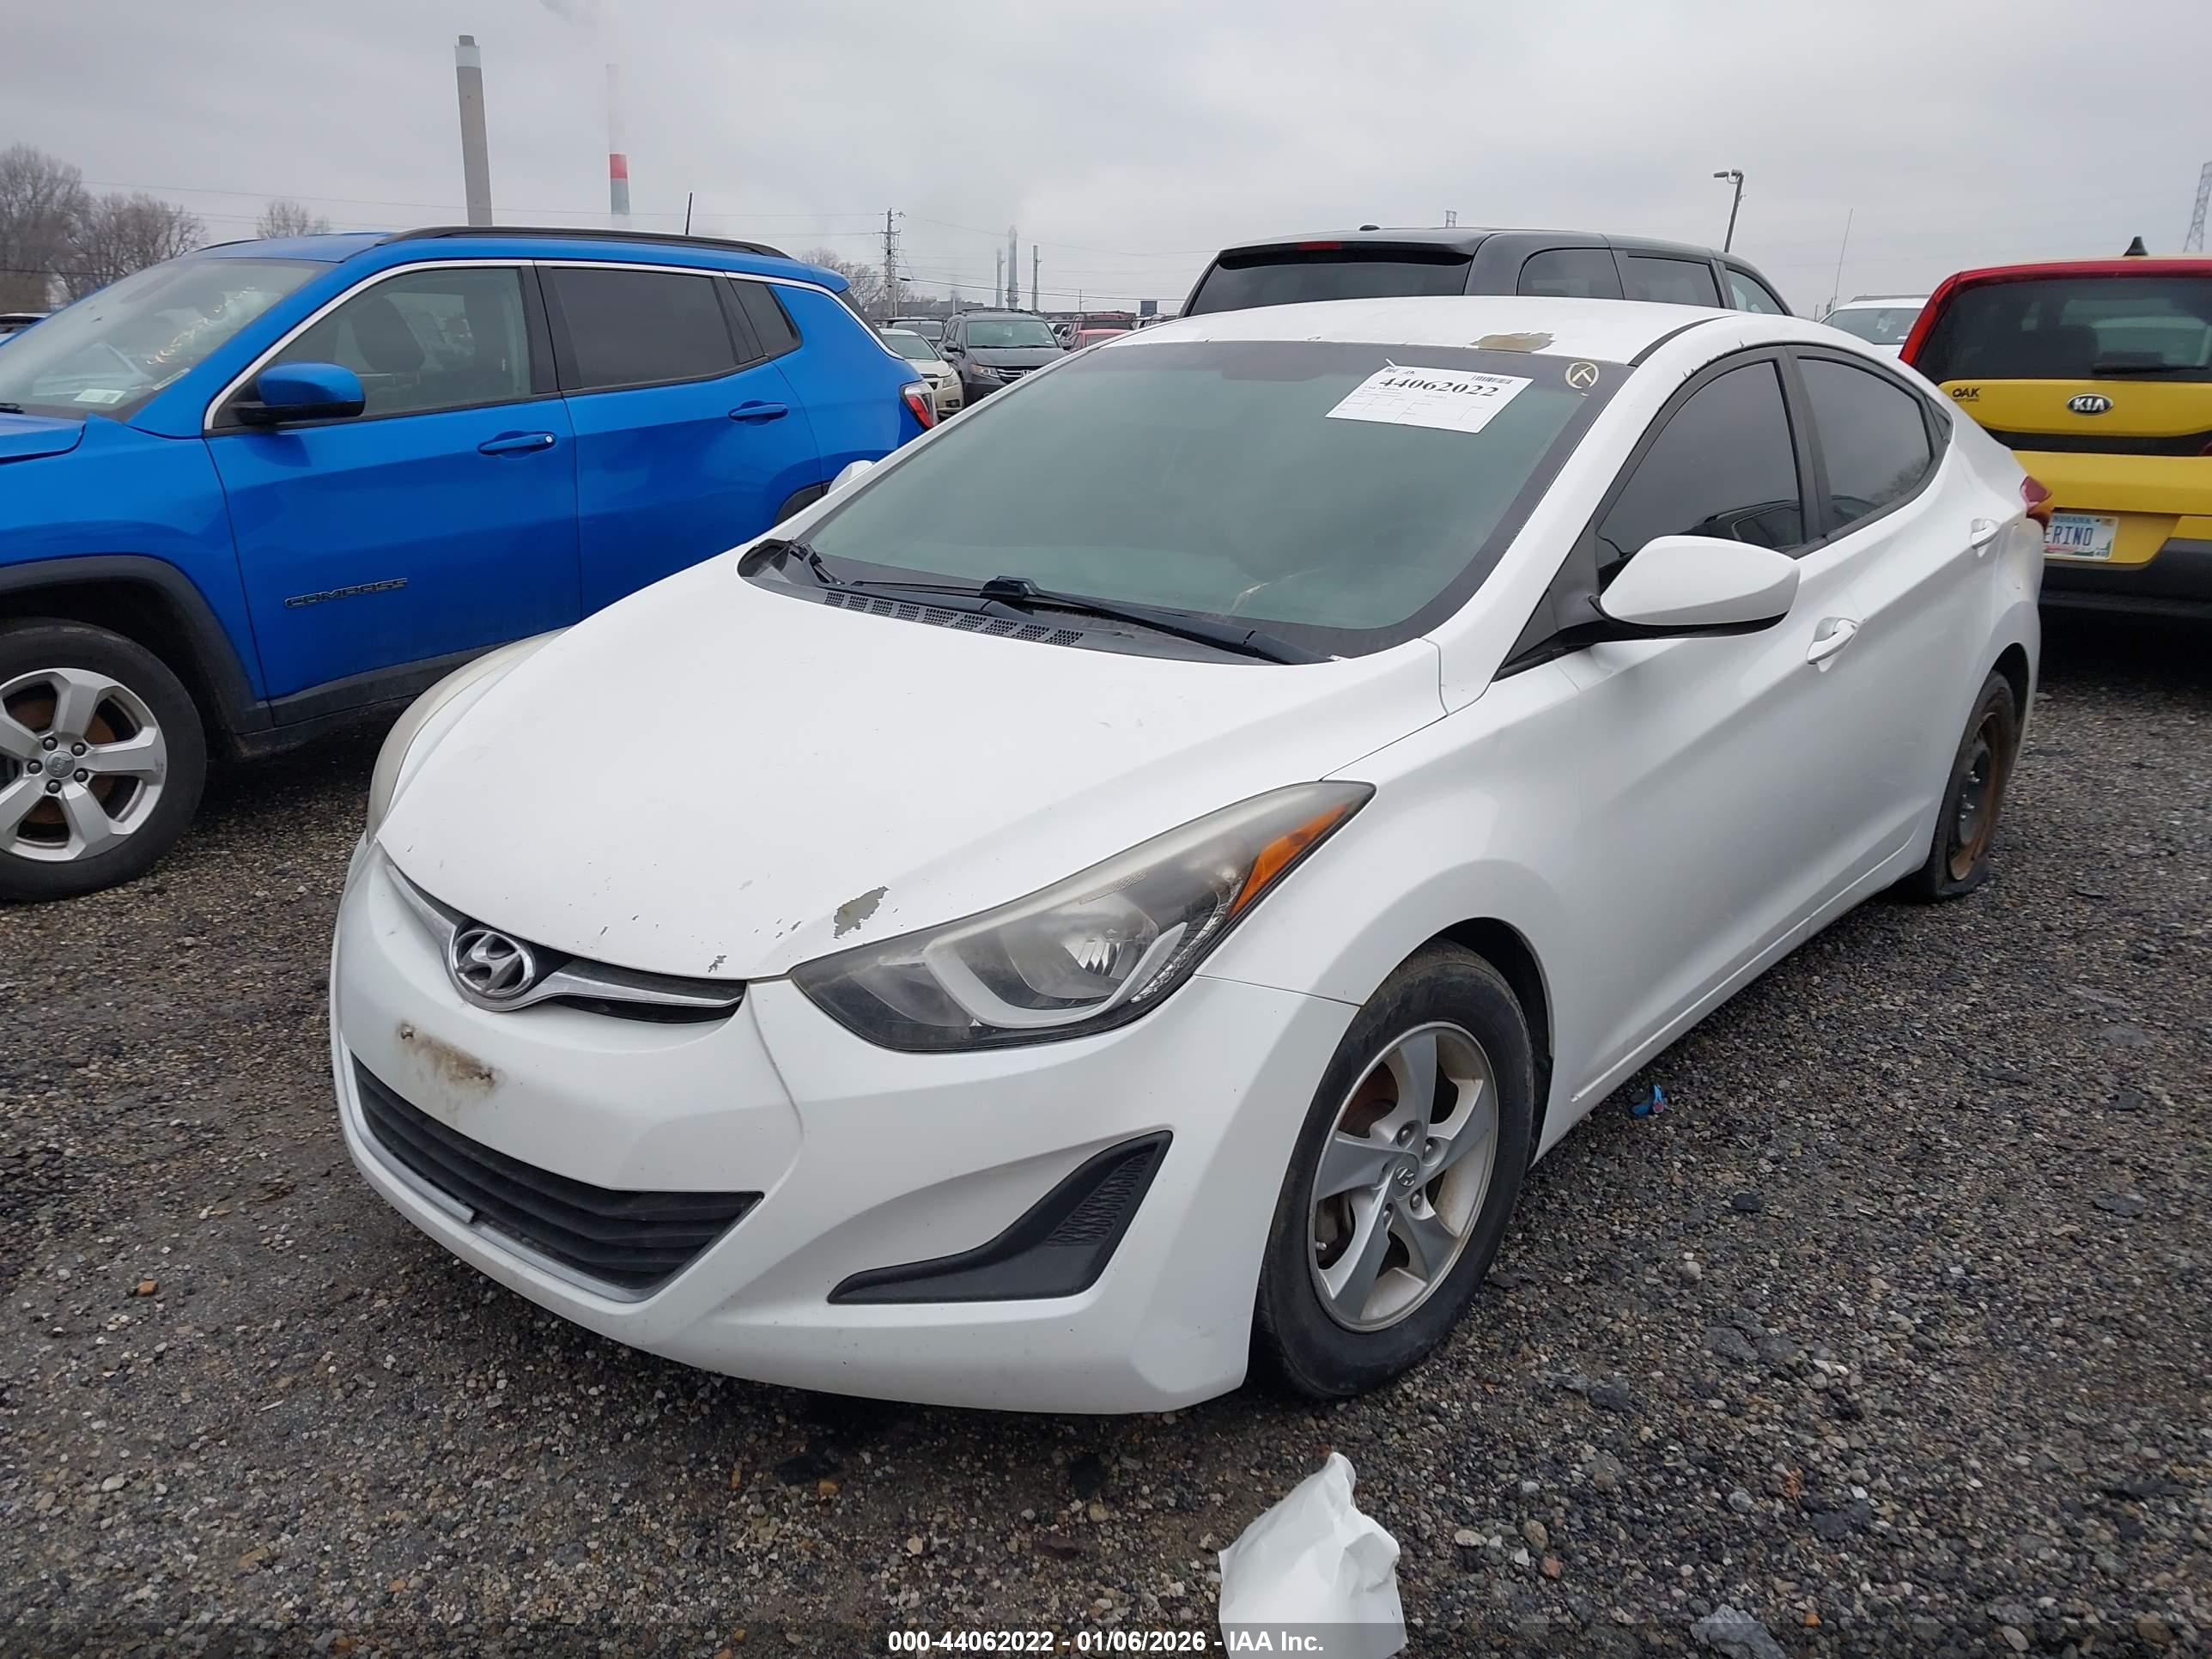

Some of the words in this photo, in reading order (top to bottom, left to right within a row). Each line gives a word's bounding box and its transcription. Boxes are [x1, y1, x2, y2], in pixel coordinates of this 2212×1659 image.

[1378, 376, 1500, 398] 44062022
[1952, 387, 1980, 398] OAK
[2073, 397, 2106, 411] KIA
[284, 577, 409, 609] COMPASS
